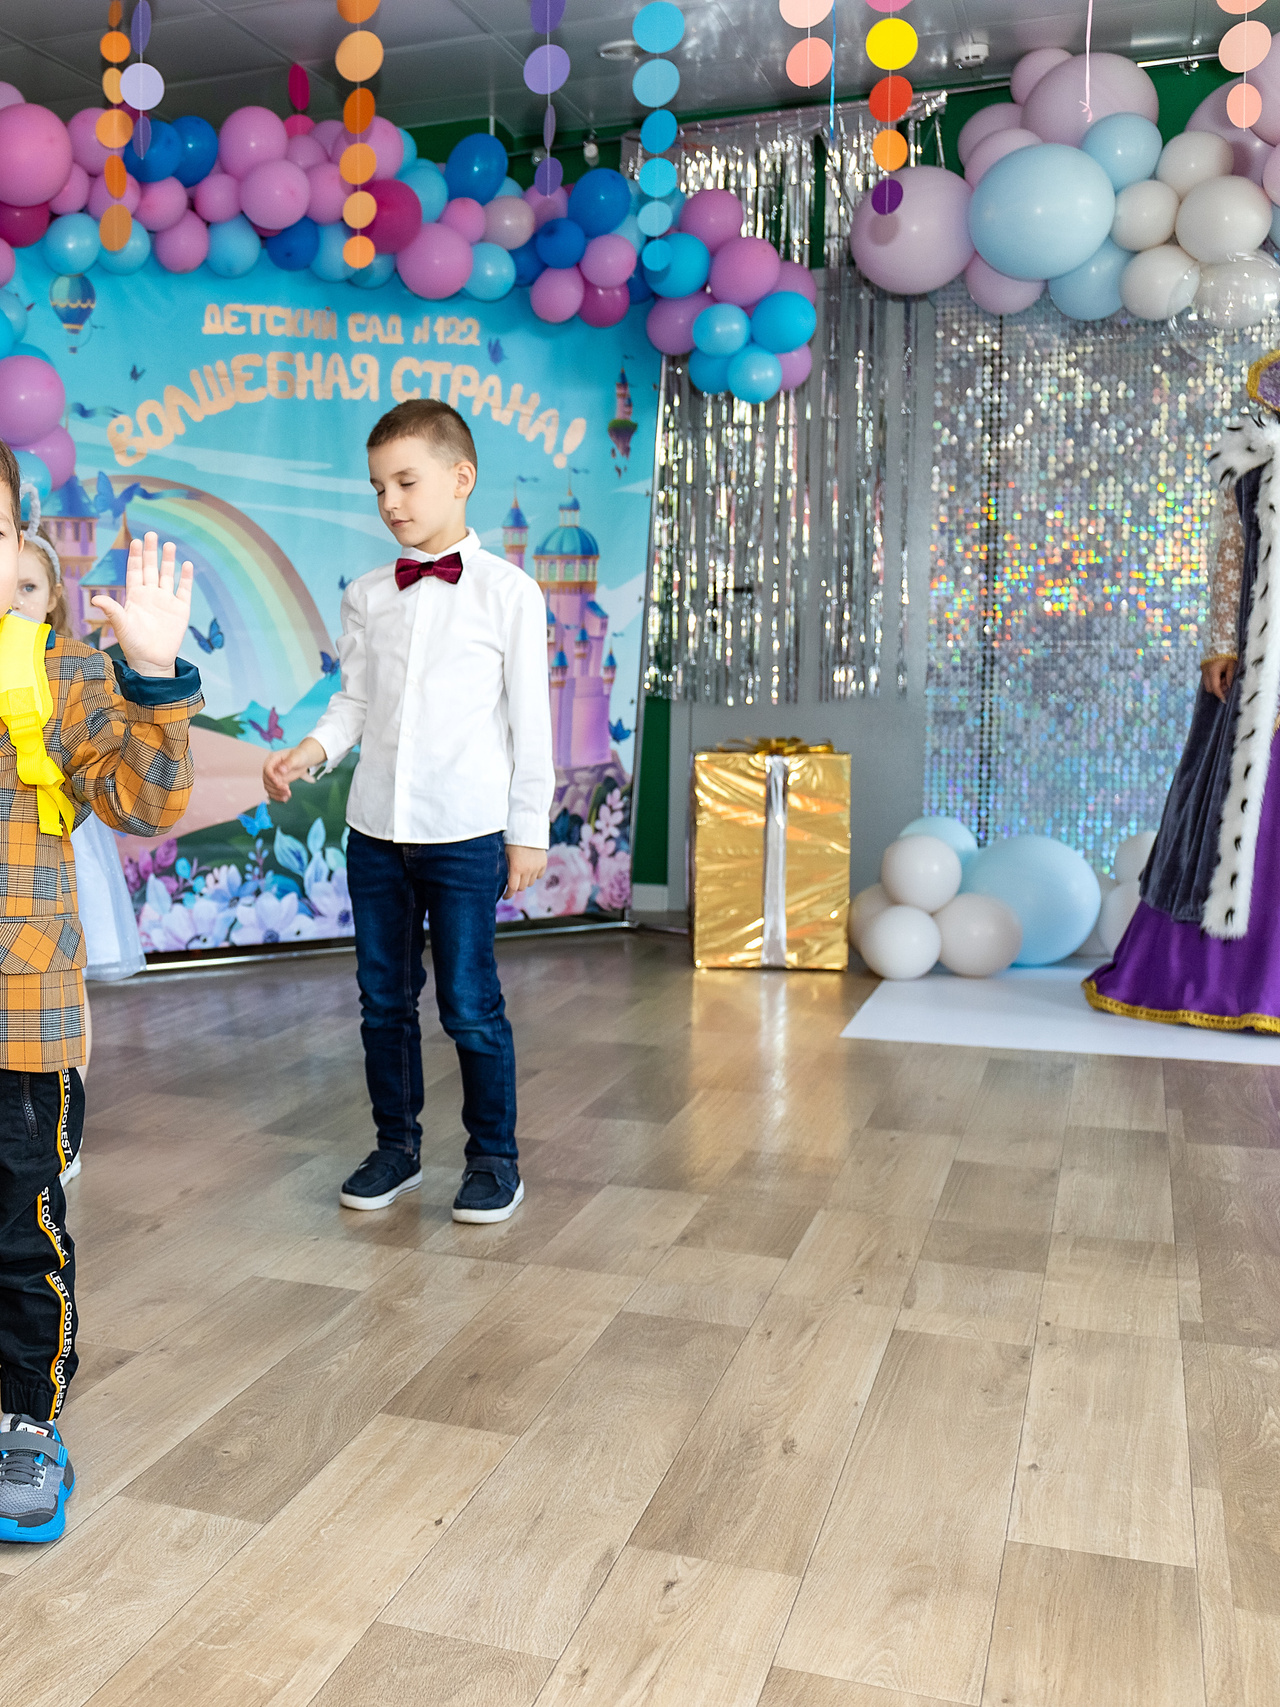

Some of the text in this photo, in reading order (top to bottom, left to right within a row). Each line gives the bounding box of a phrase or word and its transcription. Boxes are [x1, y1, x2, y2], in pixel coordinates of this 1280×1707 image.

[201, 303, 338, 340] ДЕТСКИЙ
[347, 312, 405, 345] САД
[106, 351, 587, 470] ВОЛШЕБНАЯ СТРАНА!
[60, 1093, 74, 1157] COOLEST
[61, 1301, 73, 1359] COOLEST
